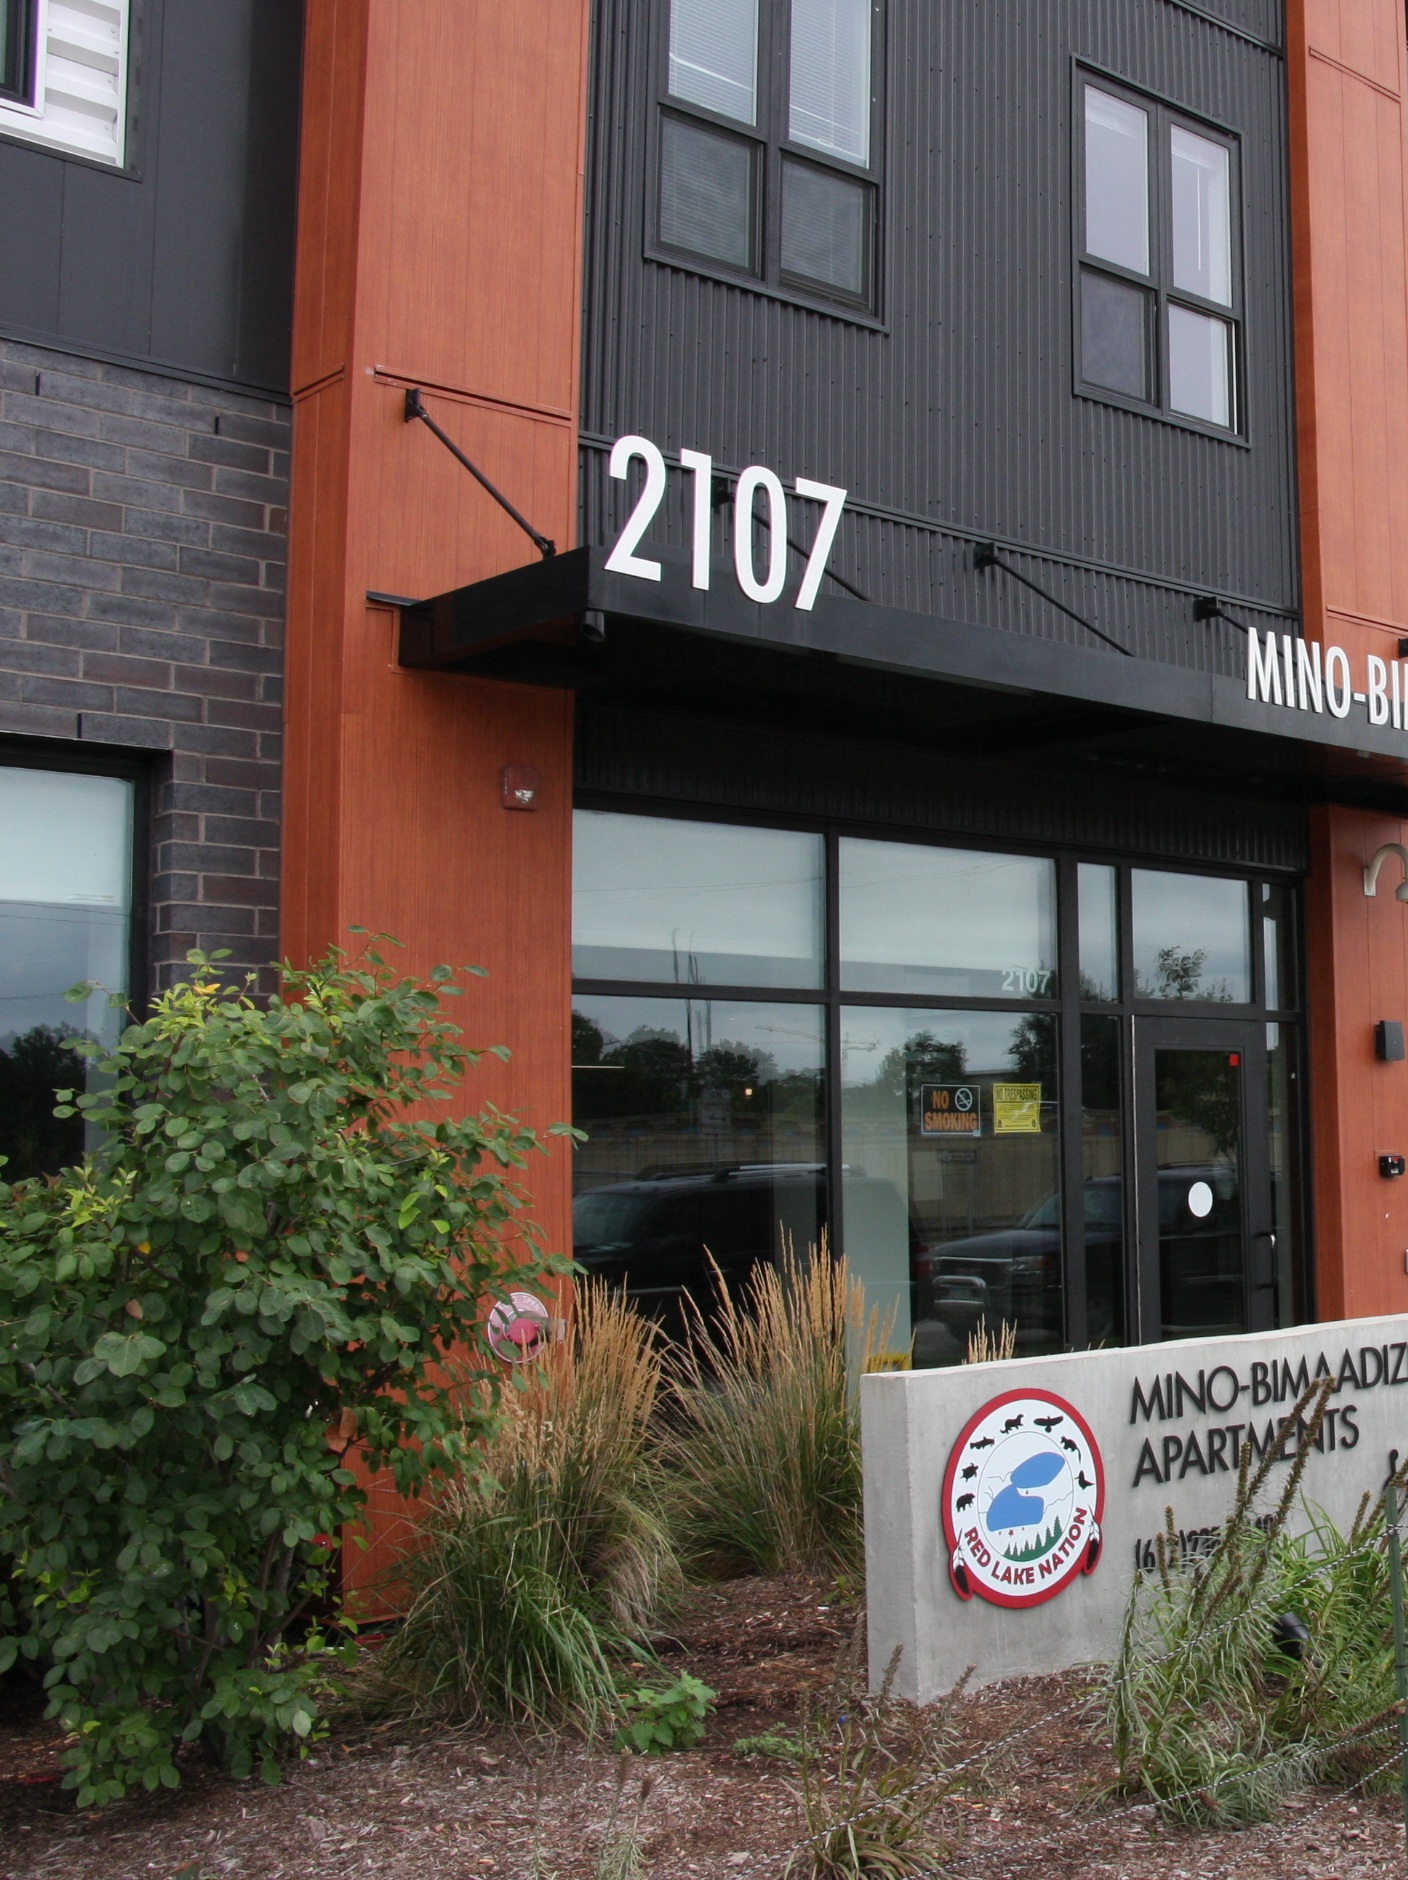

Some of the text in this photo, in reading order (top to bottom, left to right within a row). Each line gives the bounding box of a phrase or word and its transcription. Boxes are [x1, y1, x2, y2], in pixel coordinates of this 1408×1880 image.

[604, 435, 847, 611] 2107
[1002, 969, 1050, 993] 2107
[932, 1090, 949, 1109] NO
[925, 1112, 977, 1130] SMOKING
[964, 1526, 992, 1568] RED
[991, 1560, 1036, 1585] LAKE
[1038, 1507, 1088, 1580] NATION
